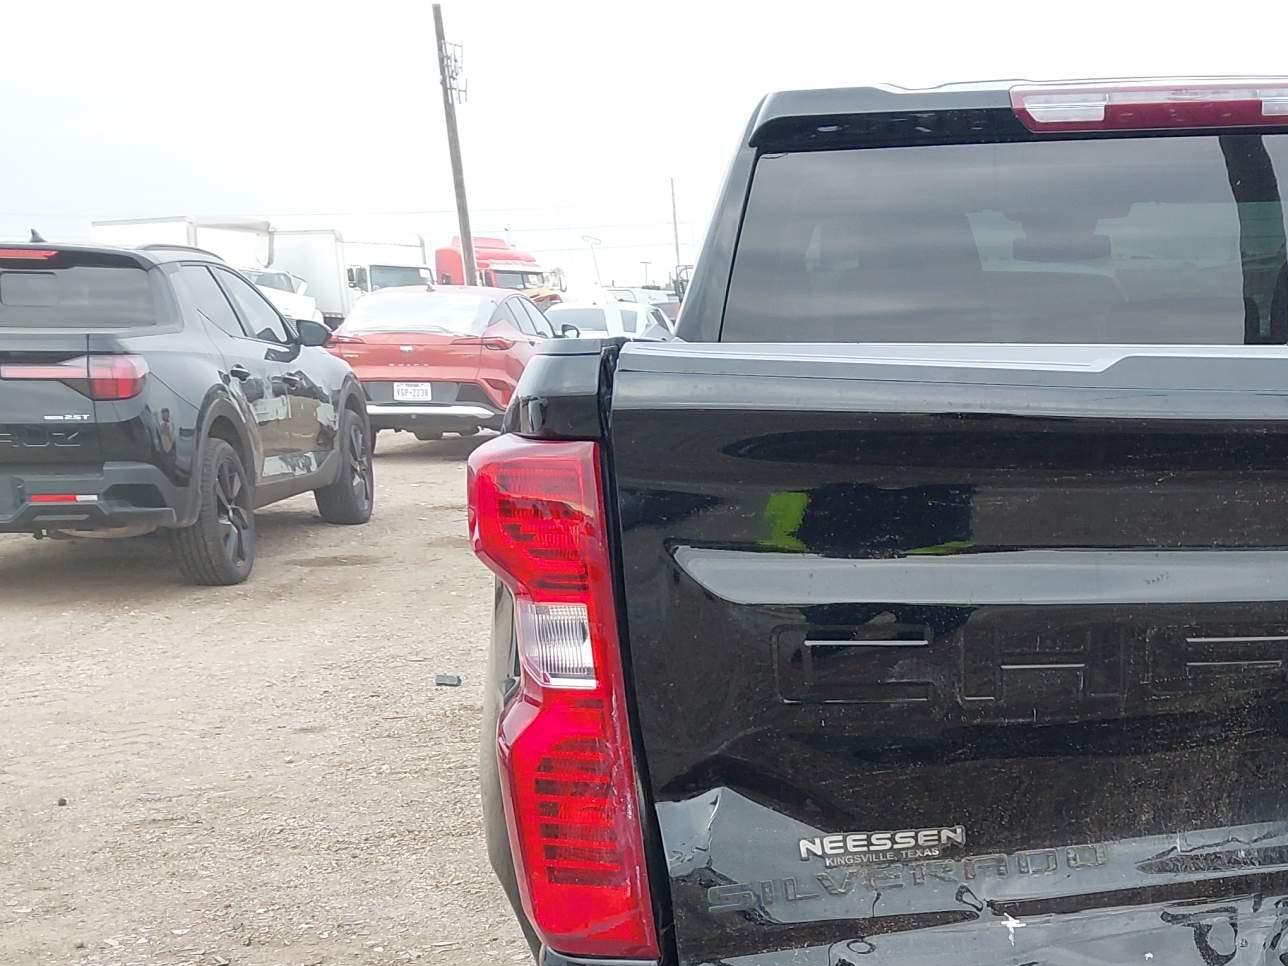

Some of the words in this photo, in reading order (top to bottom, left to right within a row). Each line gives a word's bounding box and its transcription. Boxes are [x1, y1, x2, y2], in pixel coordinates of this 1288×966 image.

[799, 825, 966, 861] NEESSEN
[825, 852, 899, 867] KINGSVILLE,
[901, 847, 940, 859] TEXAS
[706, 844, 1110, 914] SILVERADO
